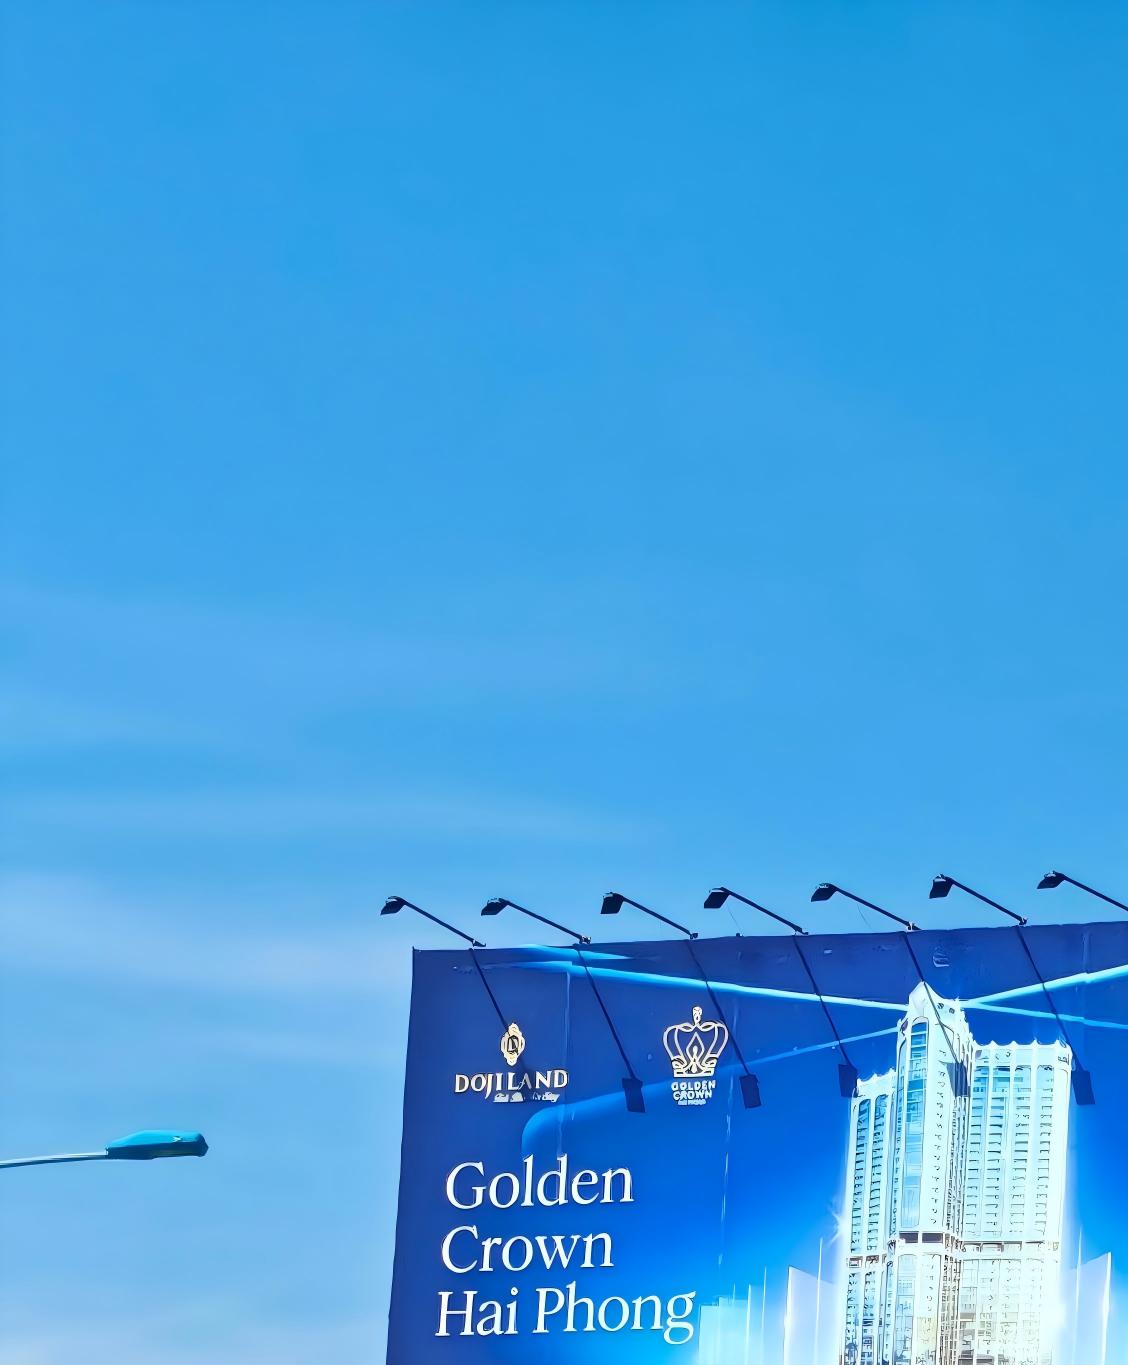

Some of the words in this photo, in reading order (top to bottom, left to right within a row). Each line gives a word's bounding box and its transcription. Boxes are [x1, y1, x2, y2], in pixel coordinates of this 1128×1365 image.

[454, 1069, 569, 1100] DOJILAND
[673, 1089, 713, 1101] CROWN
[446, 1154, 634, 1209] Golden
[441, 1225, 614, 1273] Crown
[435, 1287, 518, 1337] Hai
[531, 1281, 697, 1345] Phong
